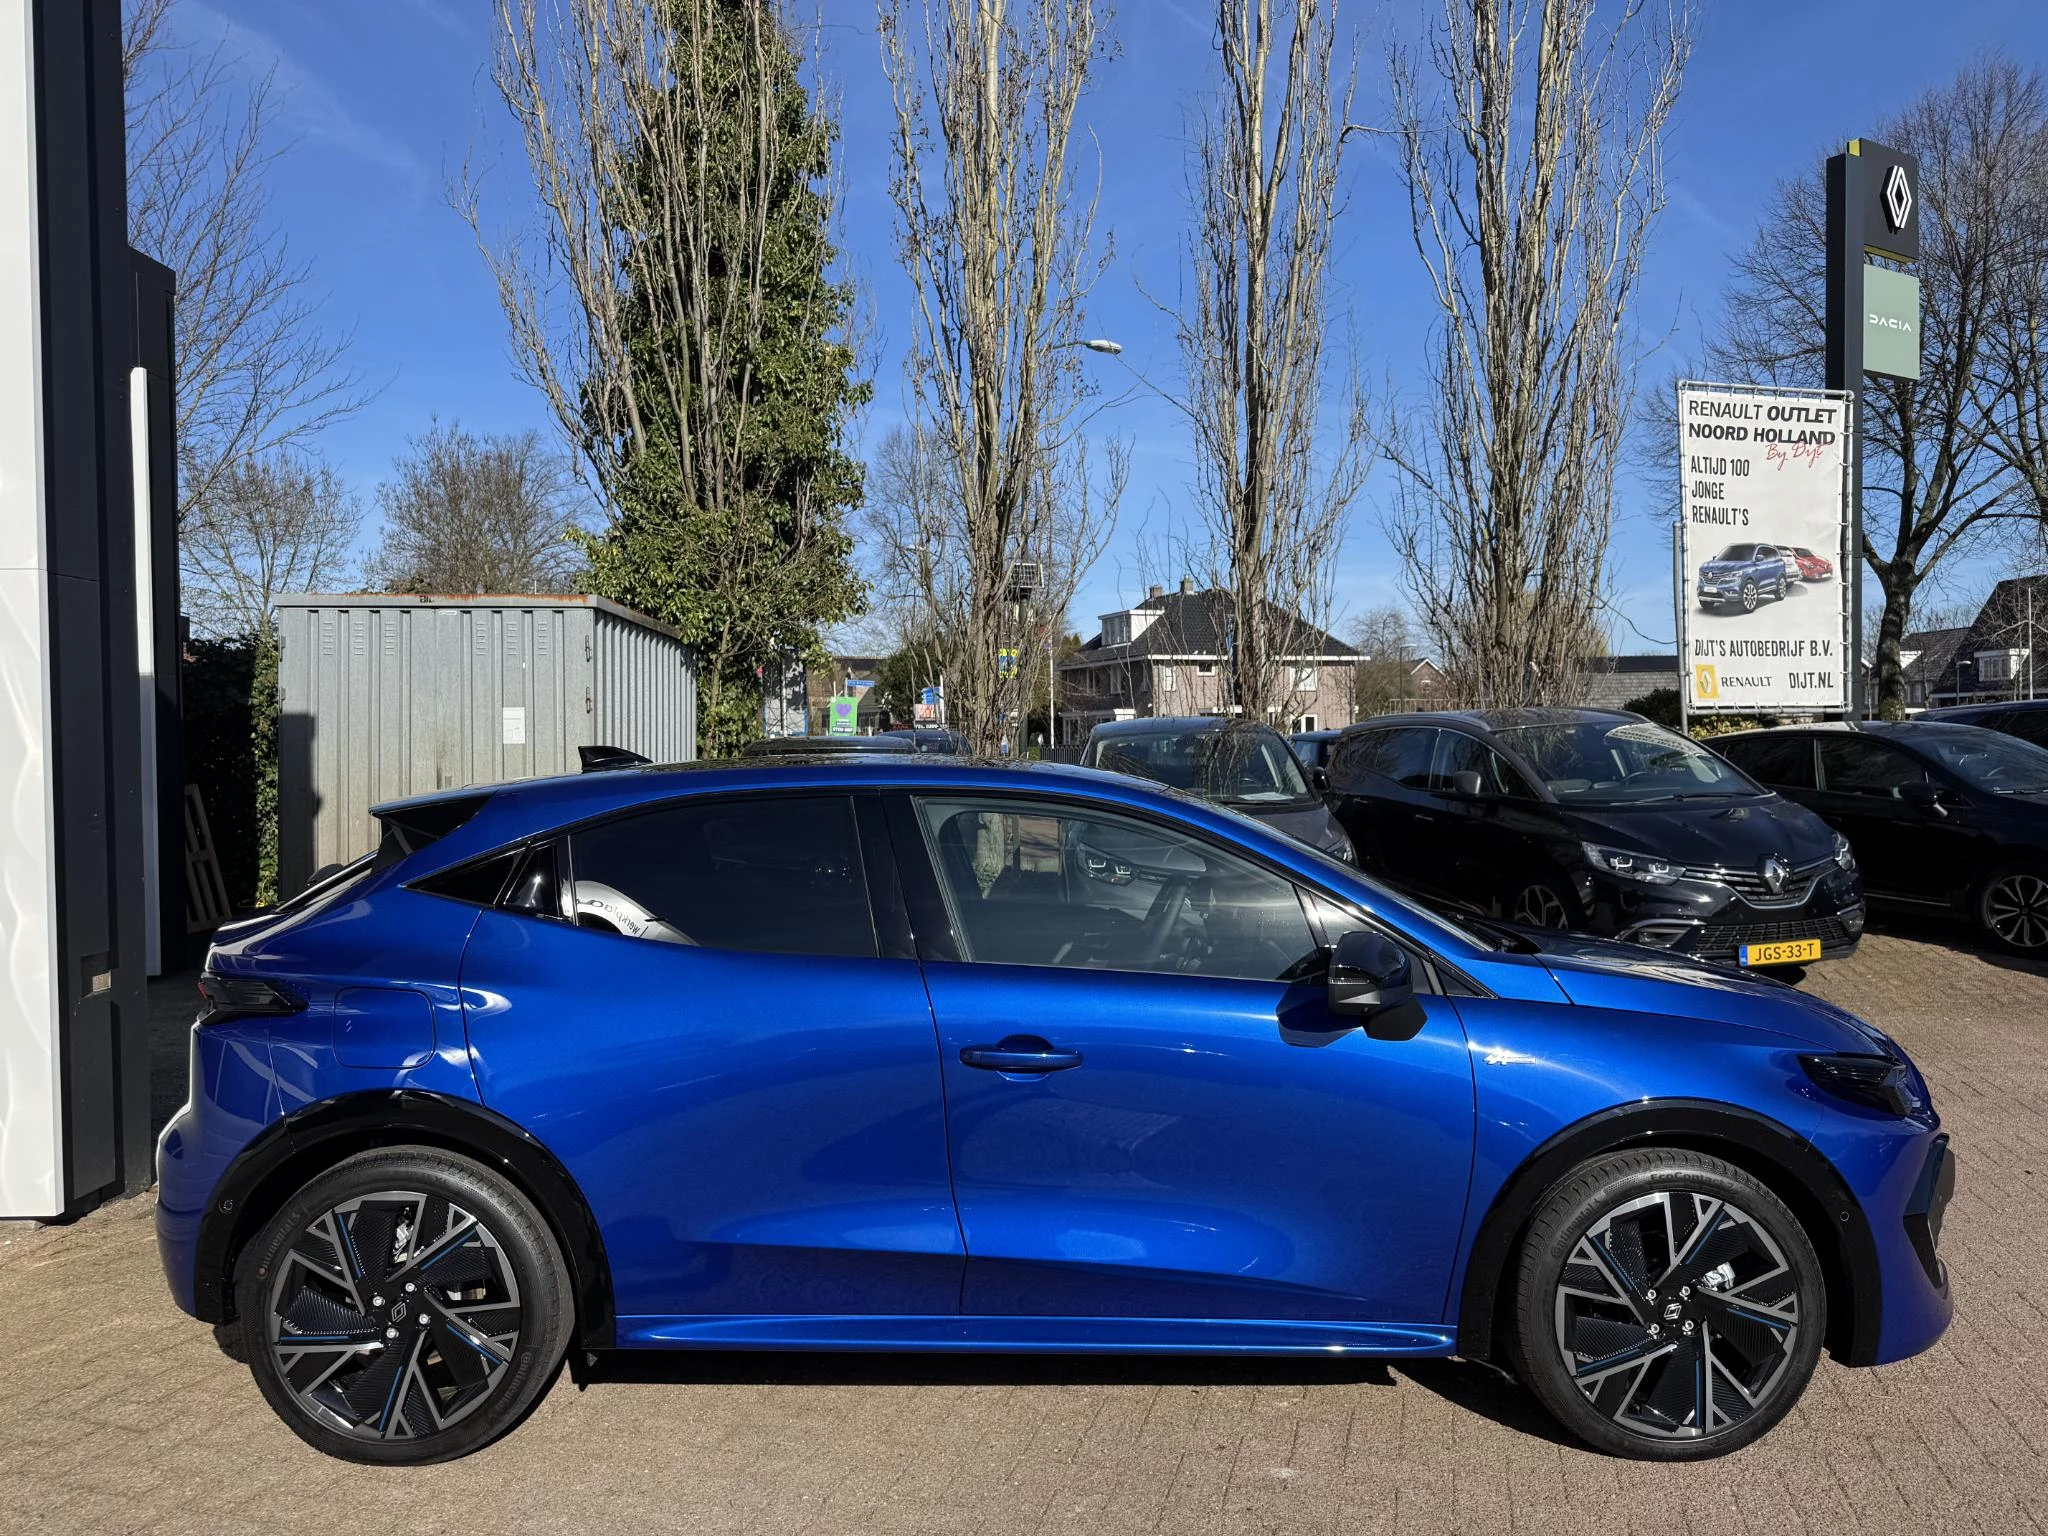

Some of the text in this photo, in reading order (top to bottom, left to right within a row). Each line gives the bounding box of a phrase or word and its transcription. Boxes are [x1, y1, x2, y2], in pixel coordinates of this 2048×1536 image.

[1869, 313, 1912, 332] DACIA
[1689, 400, 1837, 424] RENAULT OUTLET
[1689, 423, 1836, 445] NOORD HOLLAND
[1691, 455, 1750, 477] ALTIJD 100
[1765, 444, 1788, 471] By
[1692, 481, 1725, 500] JONGE
[1692, 505, 1749, 526] RENAULT'S
[1695, 639, 1833, 657] DIJT'S AUTOBEDRIJF B.V.
[1721, 676, 1772, 687] RENAULT
[1788, 672, 1834, 689] DIJT.NL
[1755, 943, 1814, 962] JGS-33-T
